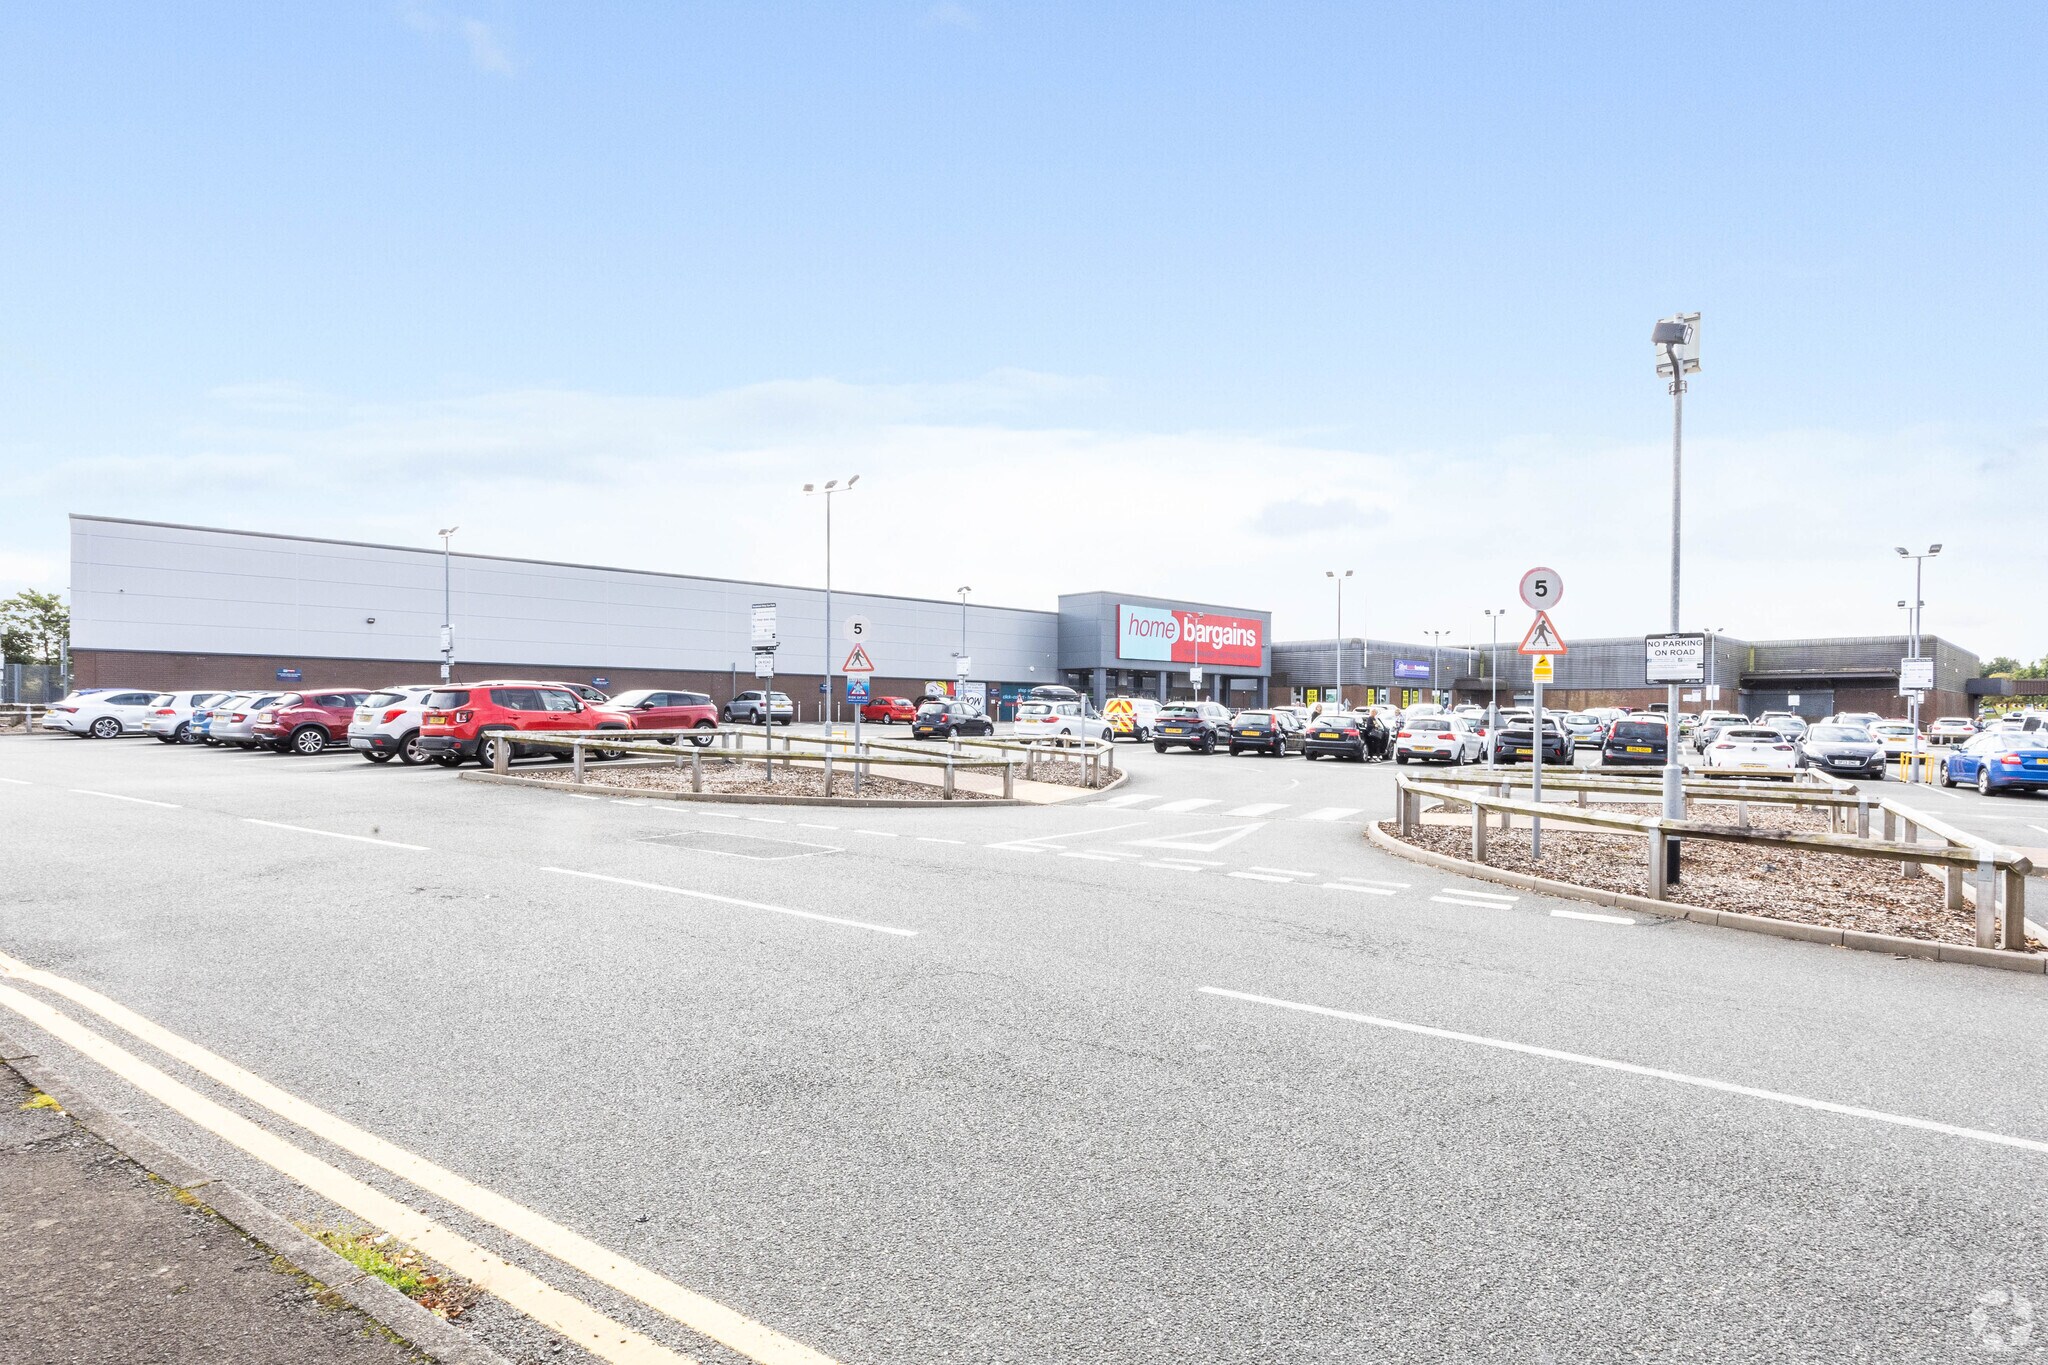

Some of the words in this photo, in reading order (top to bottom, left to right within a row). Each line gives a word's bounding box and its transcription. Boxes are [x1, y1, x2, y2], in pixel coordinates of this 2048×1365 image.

[1535, 580, 1548, 597] 5
[854, 623, 863, 635] 5
[1128, 612, 1176, 639] home
[1183, 616, 1257, 650] bargains
